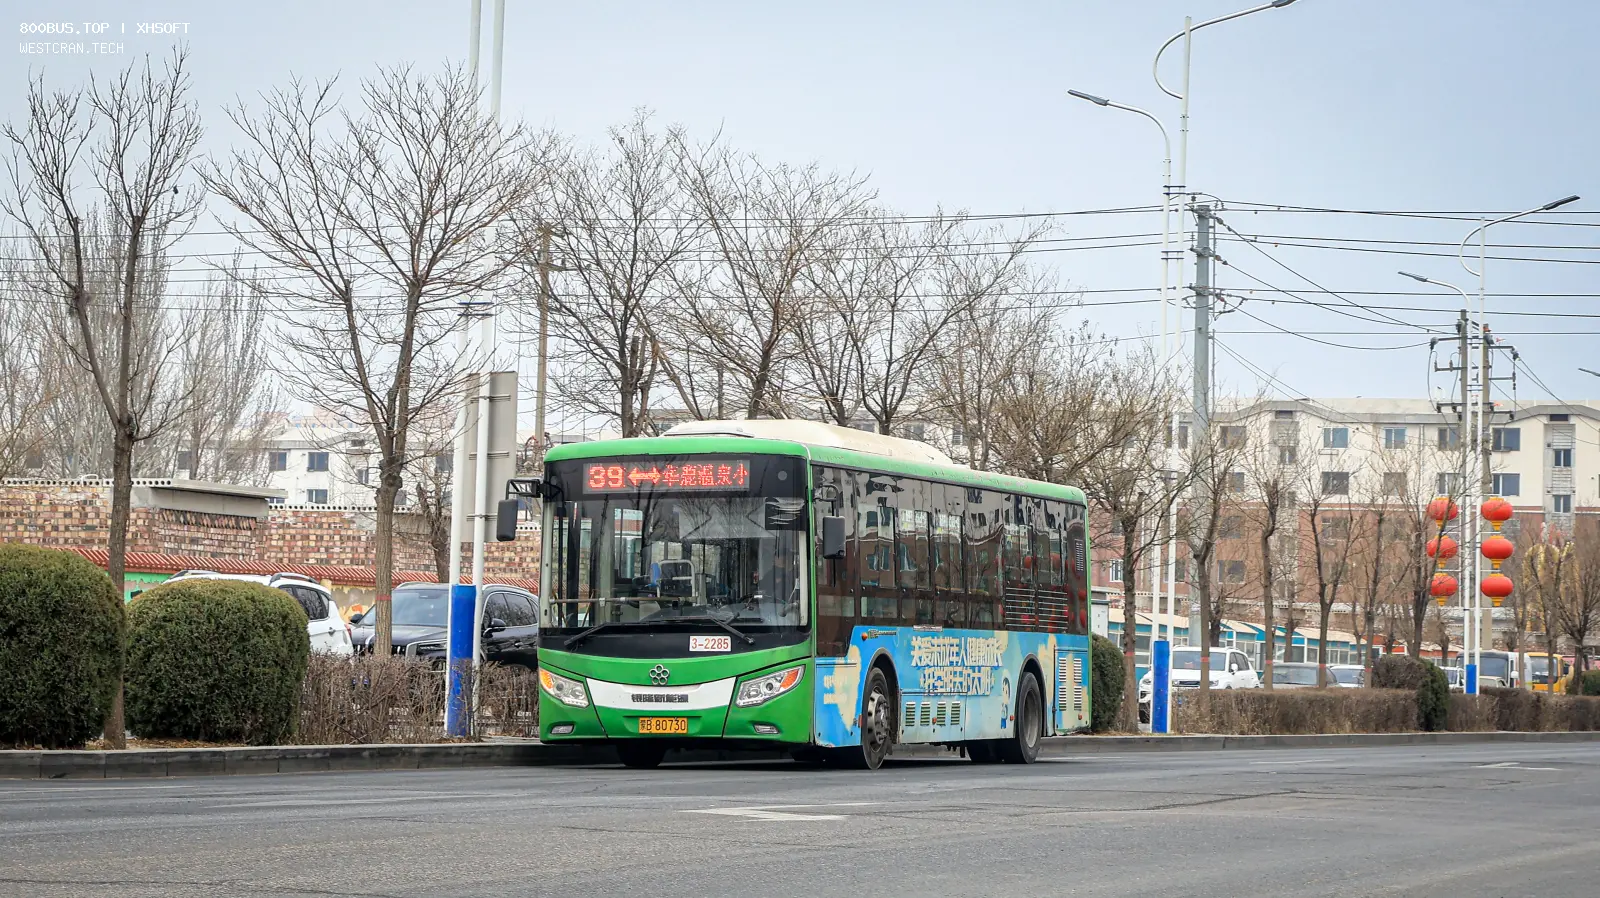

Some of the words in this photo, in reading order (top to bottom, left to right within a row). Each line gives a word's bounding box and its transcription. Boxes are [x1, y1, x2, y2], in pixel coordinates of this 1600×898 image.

[589, 466, 623, 488] 39
[691, 638, 729, 650] 3-2285
[910, 635, 1003, 667] 关爱未成年人健康成长
